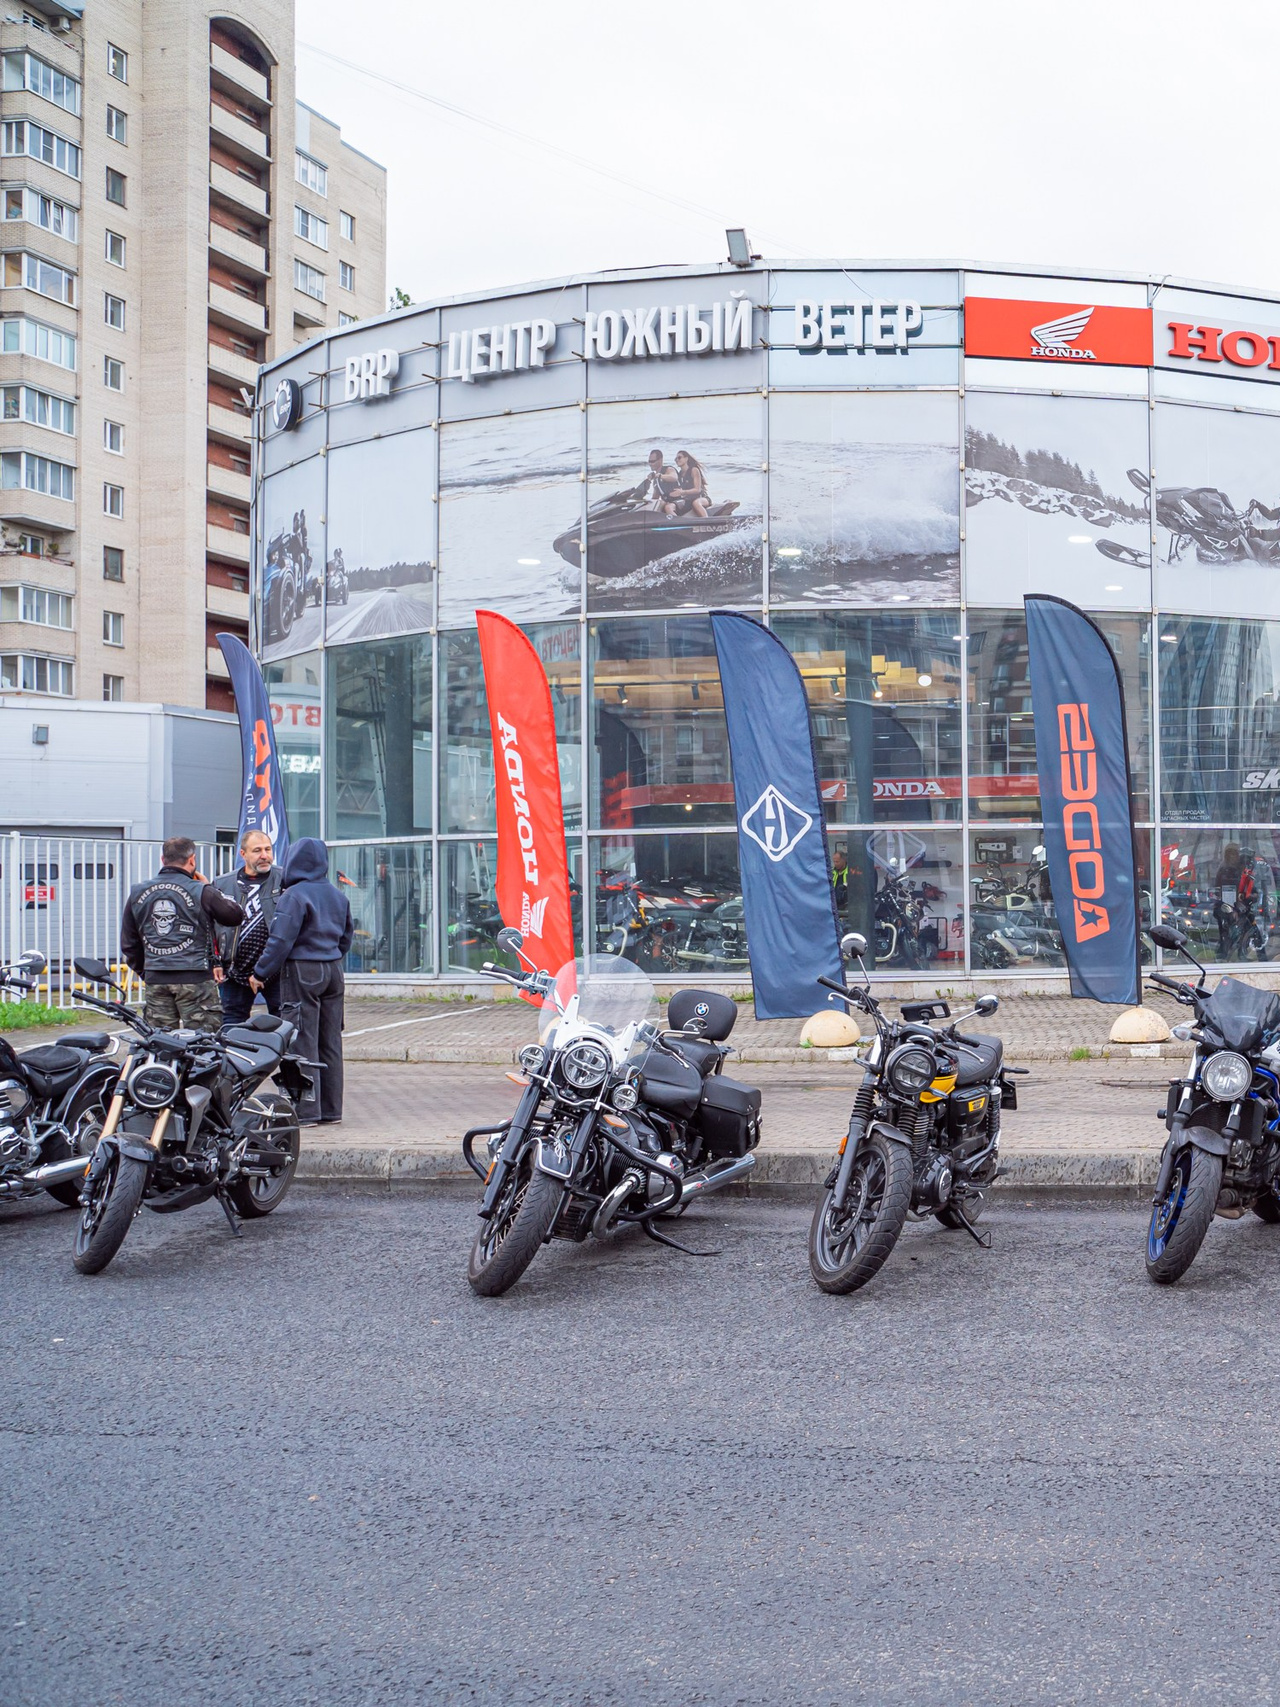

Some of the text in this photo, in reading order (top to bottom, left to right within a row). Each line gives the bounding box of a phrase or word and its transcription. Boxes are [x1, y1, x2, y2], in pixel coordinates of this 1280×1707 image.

[447, 318, 556, 383] ЦЕНТР
[585, 290, 754, 361] ЮЖНЫЙ
[795, 298, 923, 354] ВЕТЕР
[1030, 345, 1097, 360] HONDA
[843, 781, 945, 797] ONDA
[137, 883, 194, 907] THE HOOLIGANS
